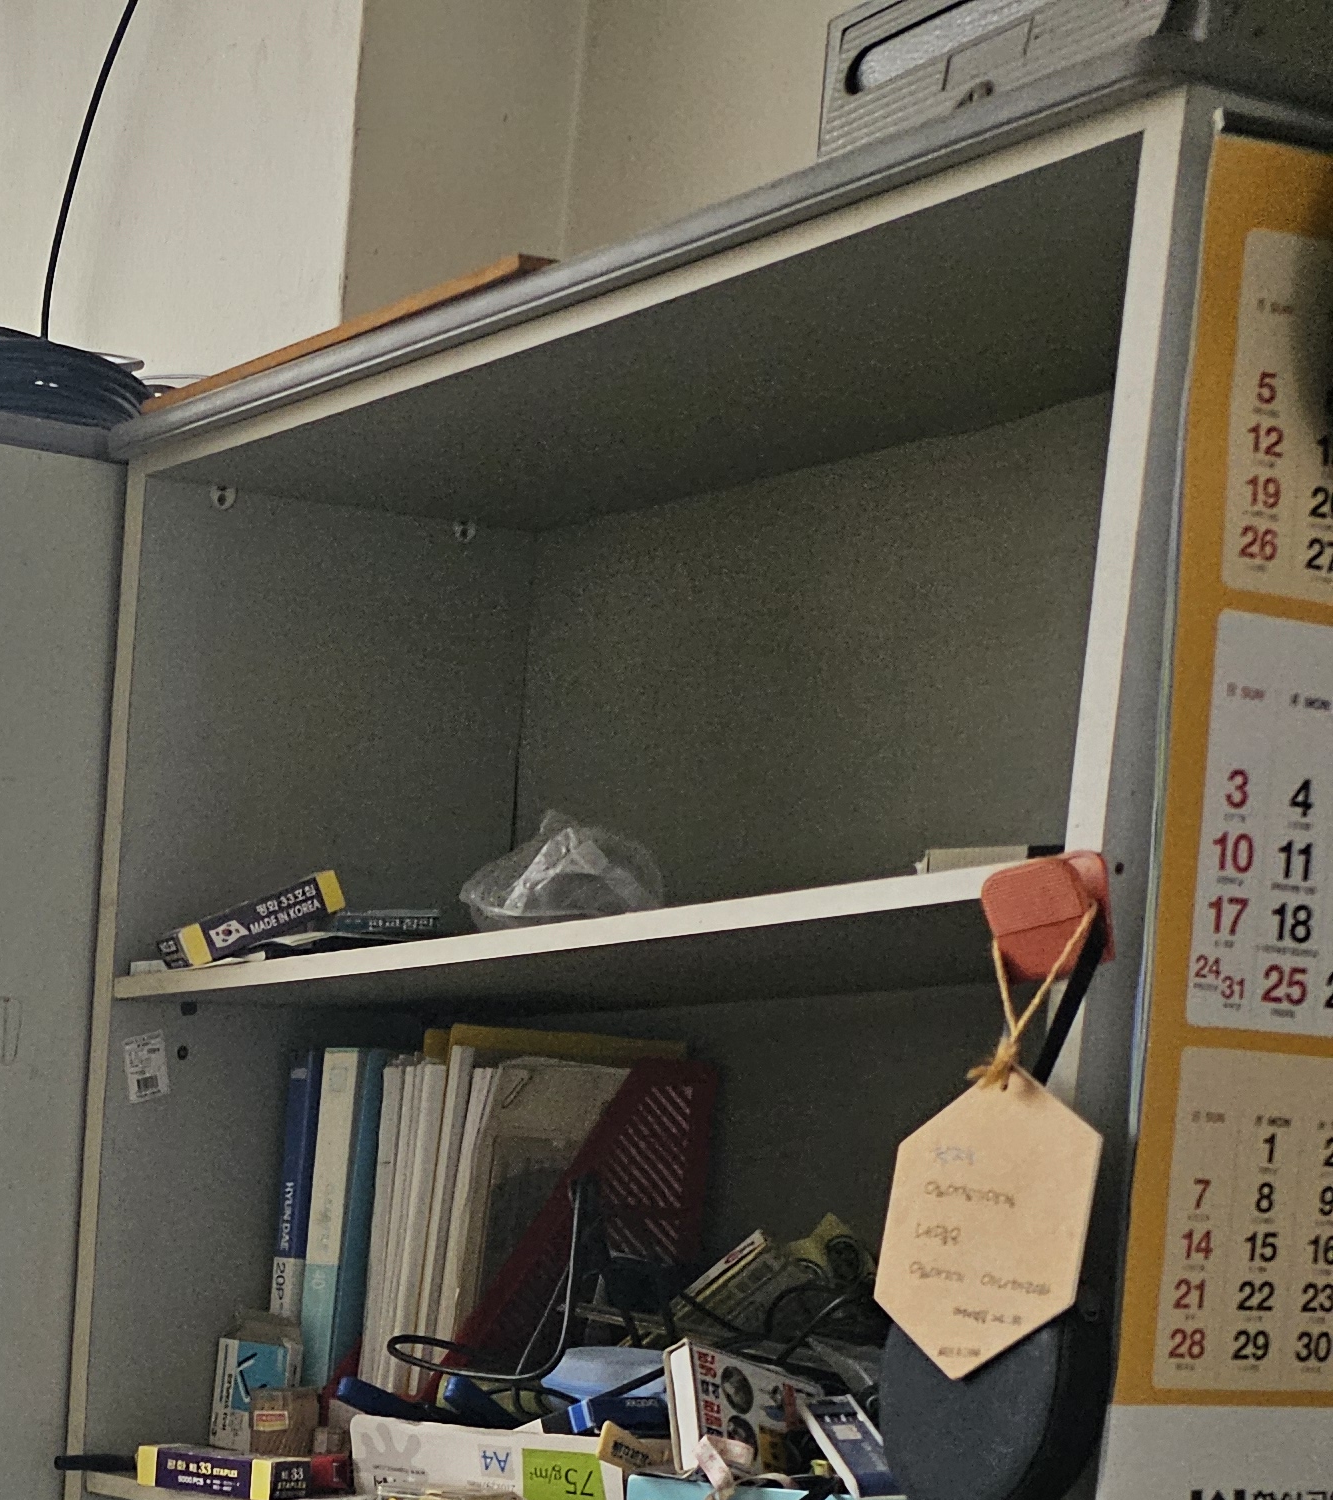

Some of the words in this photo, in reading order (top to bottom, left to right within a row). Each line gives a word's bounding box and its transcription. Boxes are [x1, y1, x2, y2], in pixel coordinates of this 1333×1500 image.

[1258, 371, 1277, 404] 5
[1247, 423, 1284, 458] 12
[1244, 475, 1282, 509] 19
[1238, 525, 1278, 561] 26
[1224, 769, 1249, 809] 3
[1290, 779, 1313, 818] 4
[1213, 833, 1254, 874] 10
[1278, 841, 1313, 882] 11
[249, 914, 278, 936] MADE
[278, 911, 289, 926] IN
[288, 898, 321, 920] KOREA
[1208, 898, 1249, 937] 17
[1272, 904, 1312, 944] 18
[1194, 955, 1221, 979] 24
[1262, 964, 1309, 1006] 25
[1221, 976, 1245, 1000] 31
[1262, 1133, 1277, 1164] 1
[1193, 1178, 1211, 1209] 7
[1255, 1182, 1274, 1213] 8
[1181, 1230, 1213, 1261] 14
[1244, 1233, 1278, 1263] 15
[1173, 1279, 1207, 1310] 21
[1237, 1282, 1275, 1313] 22
[1301, 1283, 1333, 1313] 23
[1168, 1329, 1207, 1360] 28
[1232, 1330, 1270, 1361] 29
[1295, 1332, 1332, 1363] 30
[480, 1450, 512, 1475] A4
